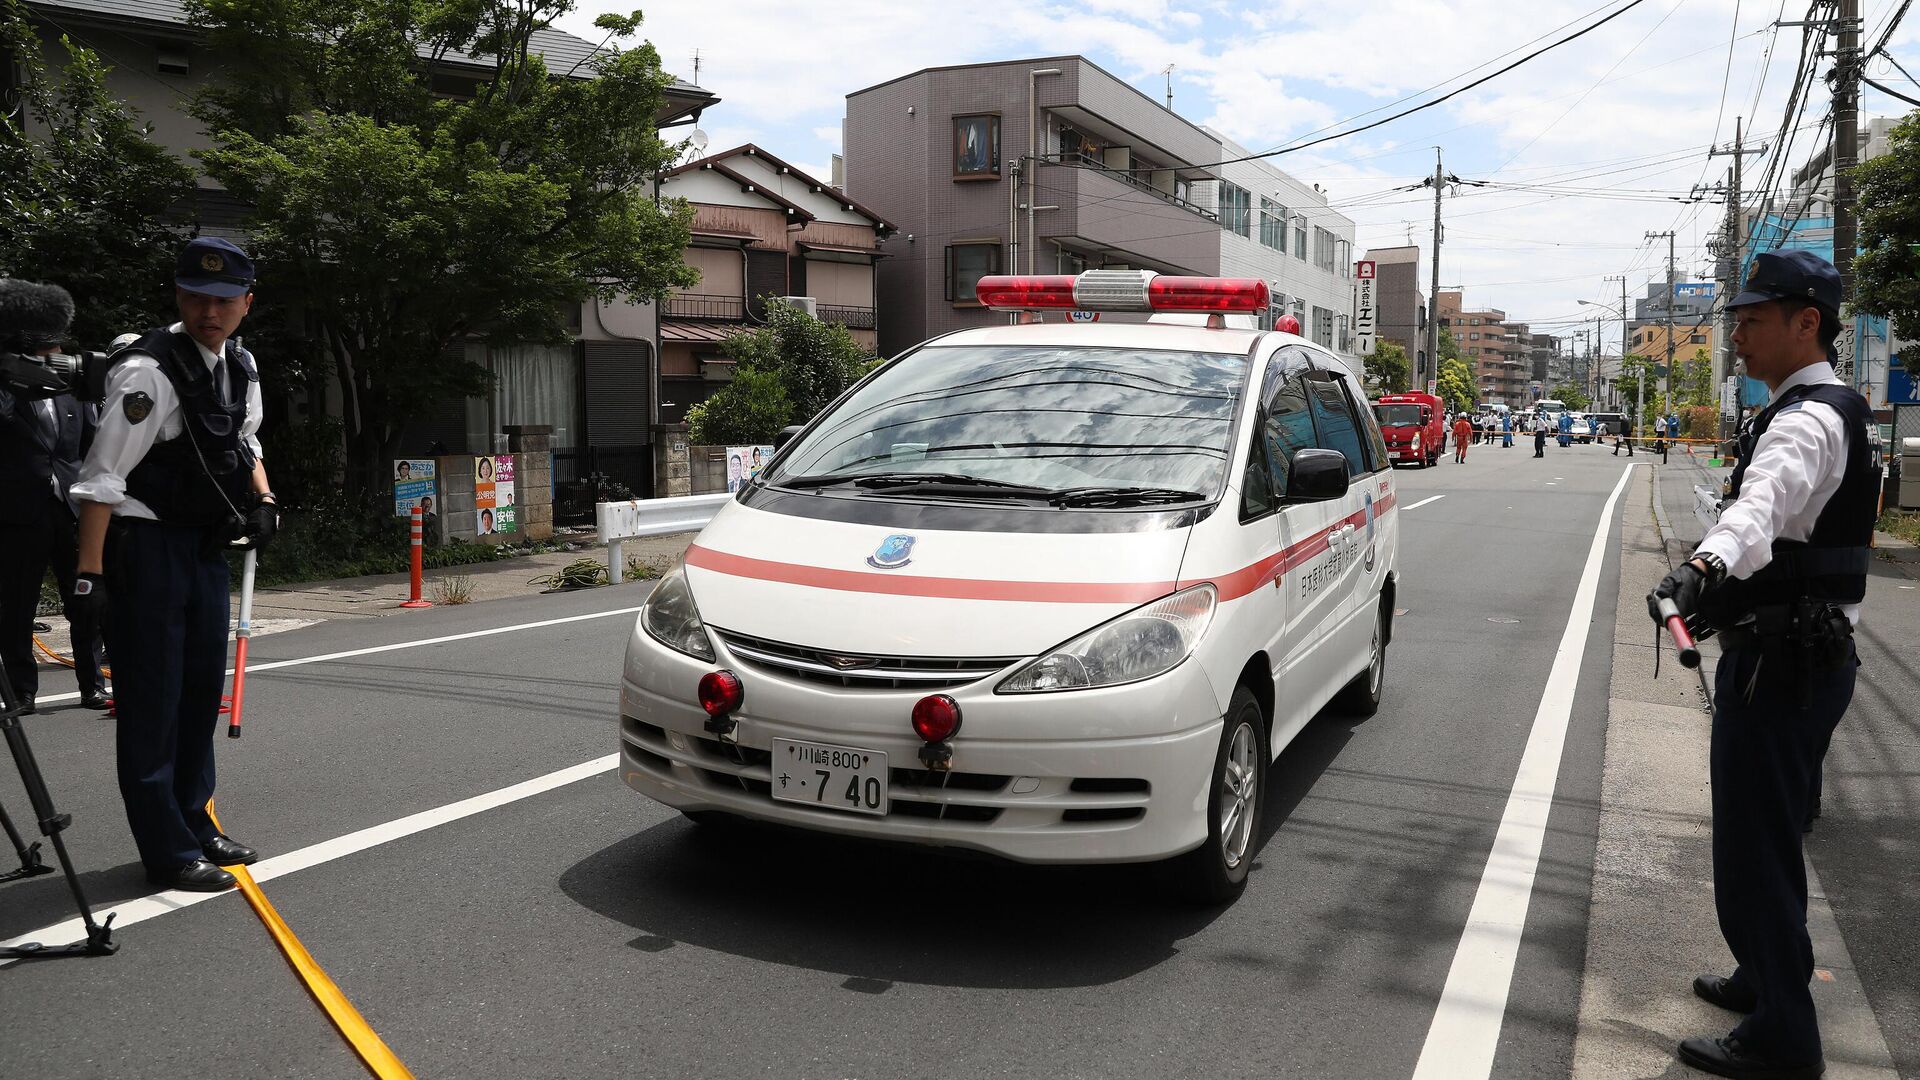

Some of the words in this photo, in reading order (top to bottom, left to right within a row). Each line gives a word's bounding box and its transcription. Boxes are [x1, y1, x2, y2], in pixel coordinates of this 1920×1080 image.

[1073, 311, 1092, 319] 40
[496, 460, 513, 473] 佐々木
[476, 490, 496, 500] 公明党
[497, 510, 515, 524] 安倍
